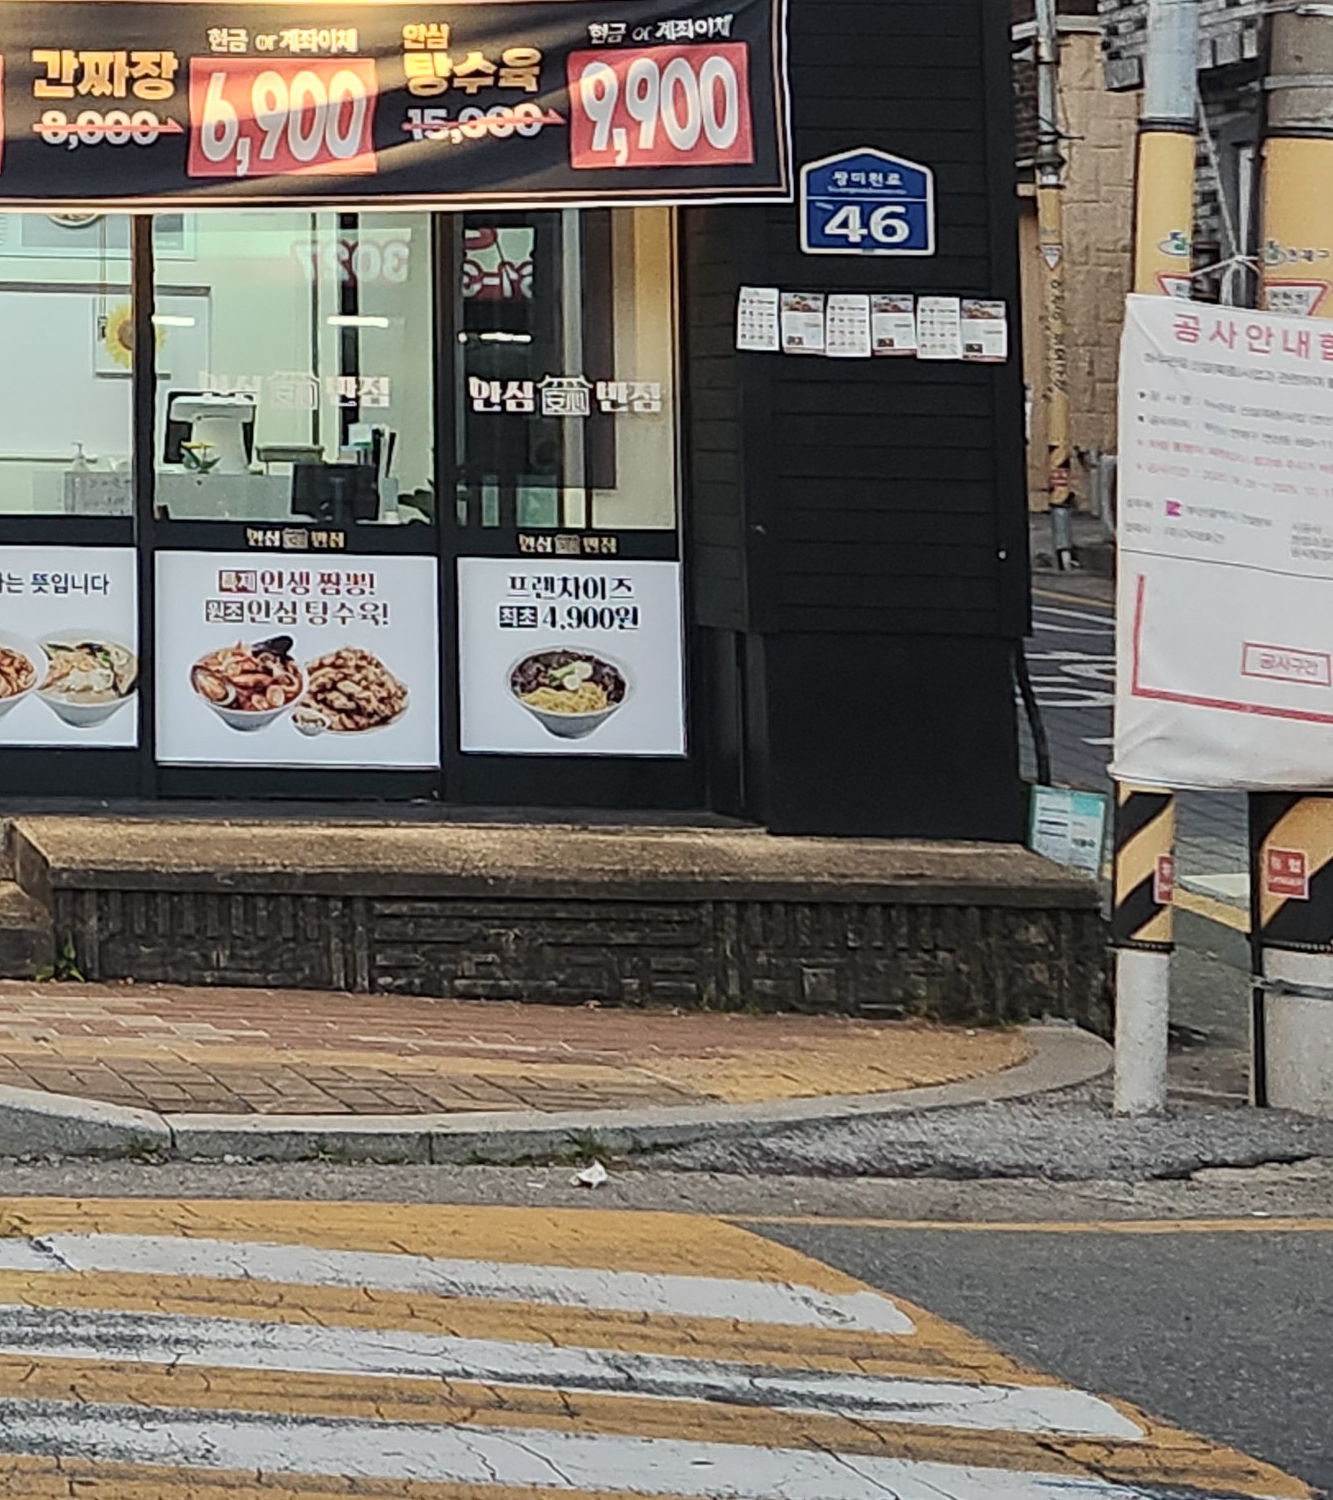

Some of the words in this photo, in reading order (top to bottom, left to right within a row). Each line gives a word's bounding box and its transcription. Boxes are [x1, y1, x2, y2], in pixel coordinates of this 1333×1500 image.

[207, 27, 248, 53] 현금
[255, 34, 278, 52] or
[279, 27, 358, 53] 계좌이체
[403, 22, 450, 51] 안심
[588, 21, 626, 44] 현금
[632, 25, 650, 43] or
[654, 13, 733, 41] 계좌이체
[32, 49, 178, 100] 간짜장
[404, 47, 543, 97] 탕수육
[201, 70, 367, 177] 6,900
[406, 102, 544, 146] 15,000
[580, 55, 739, 167] 9,900
[40, 109, 160, 151] 8,000
[824, 205, 911, 244] 46
[325, 375, 391, 407] 반점
[468, 376, 535, 412] 안심
[596, 381, 662, 412] 반점
[30, 572, 111, 595] 뜻입니다
[260, 570, 311, 596] 인생
[506, 575, 635, 601] 프랜차이즈
[246, 600, 298, 626] 안심
[305, 601, 390, 627] 탕수육!
